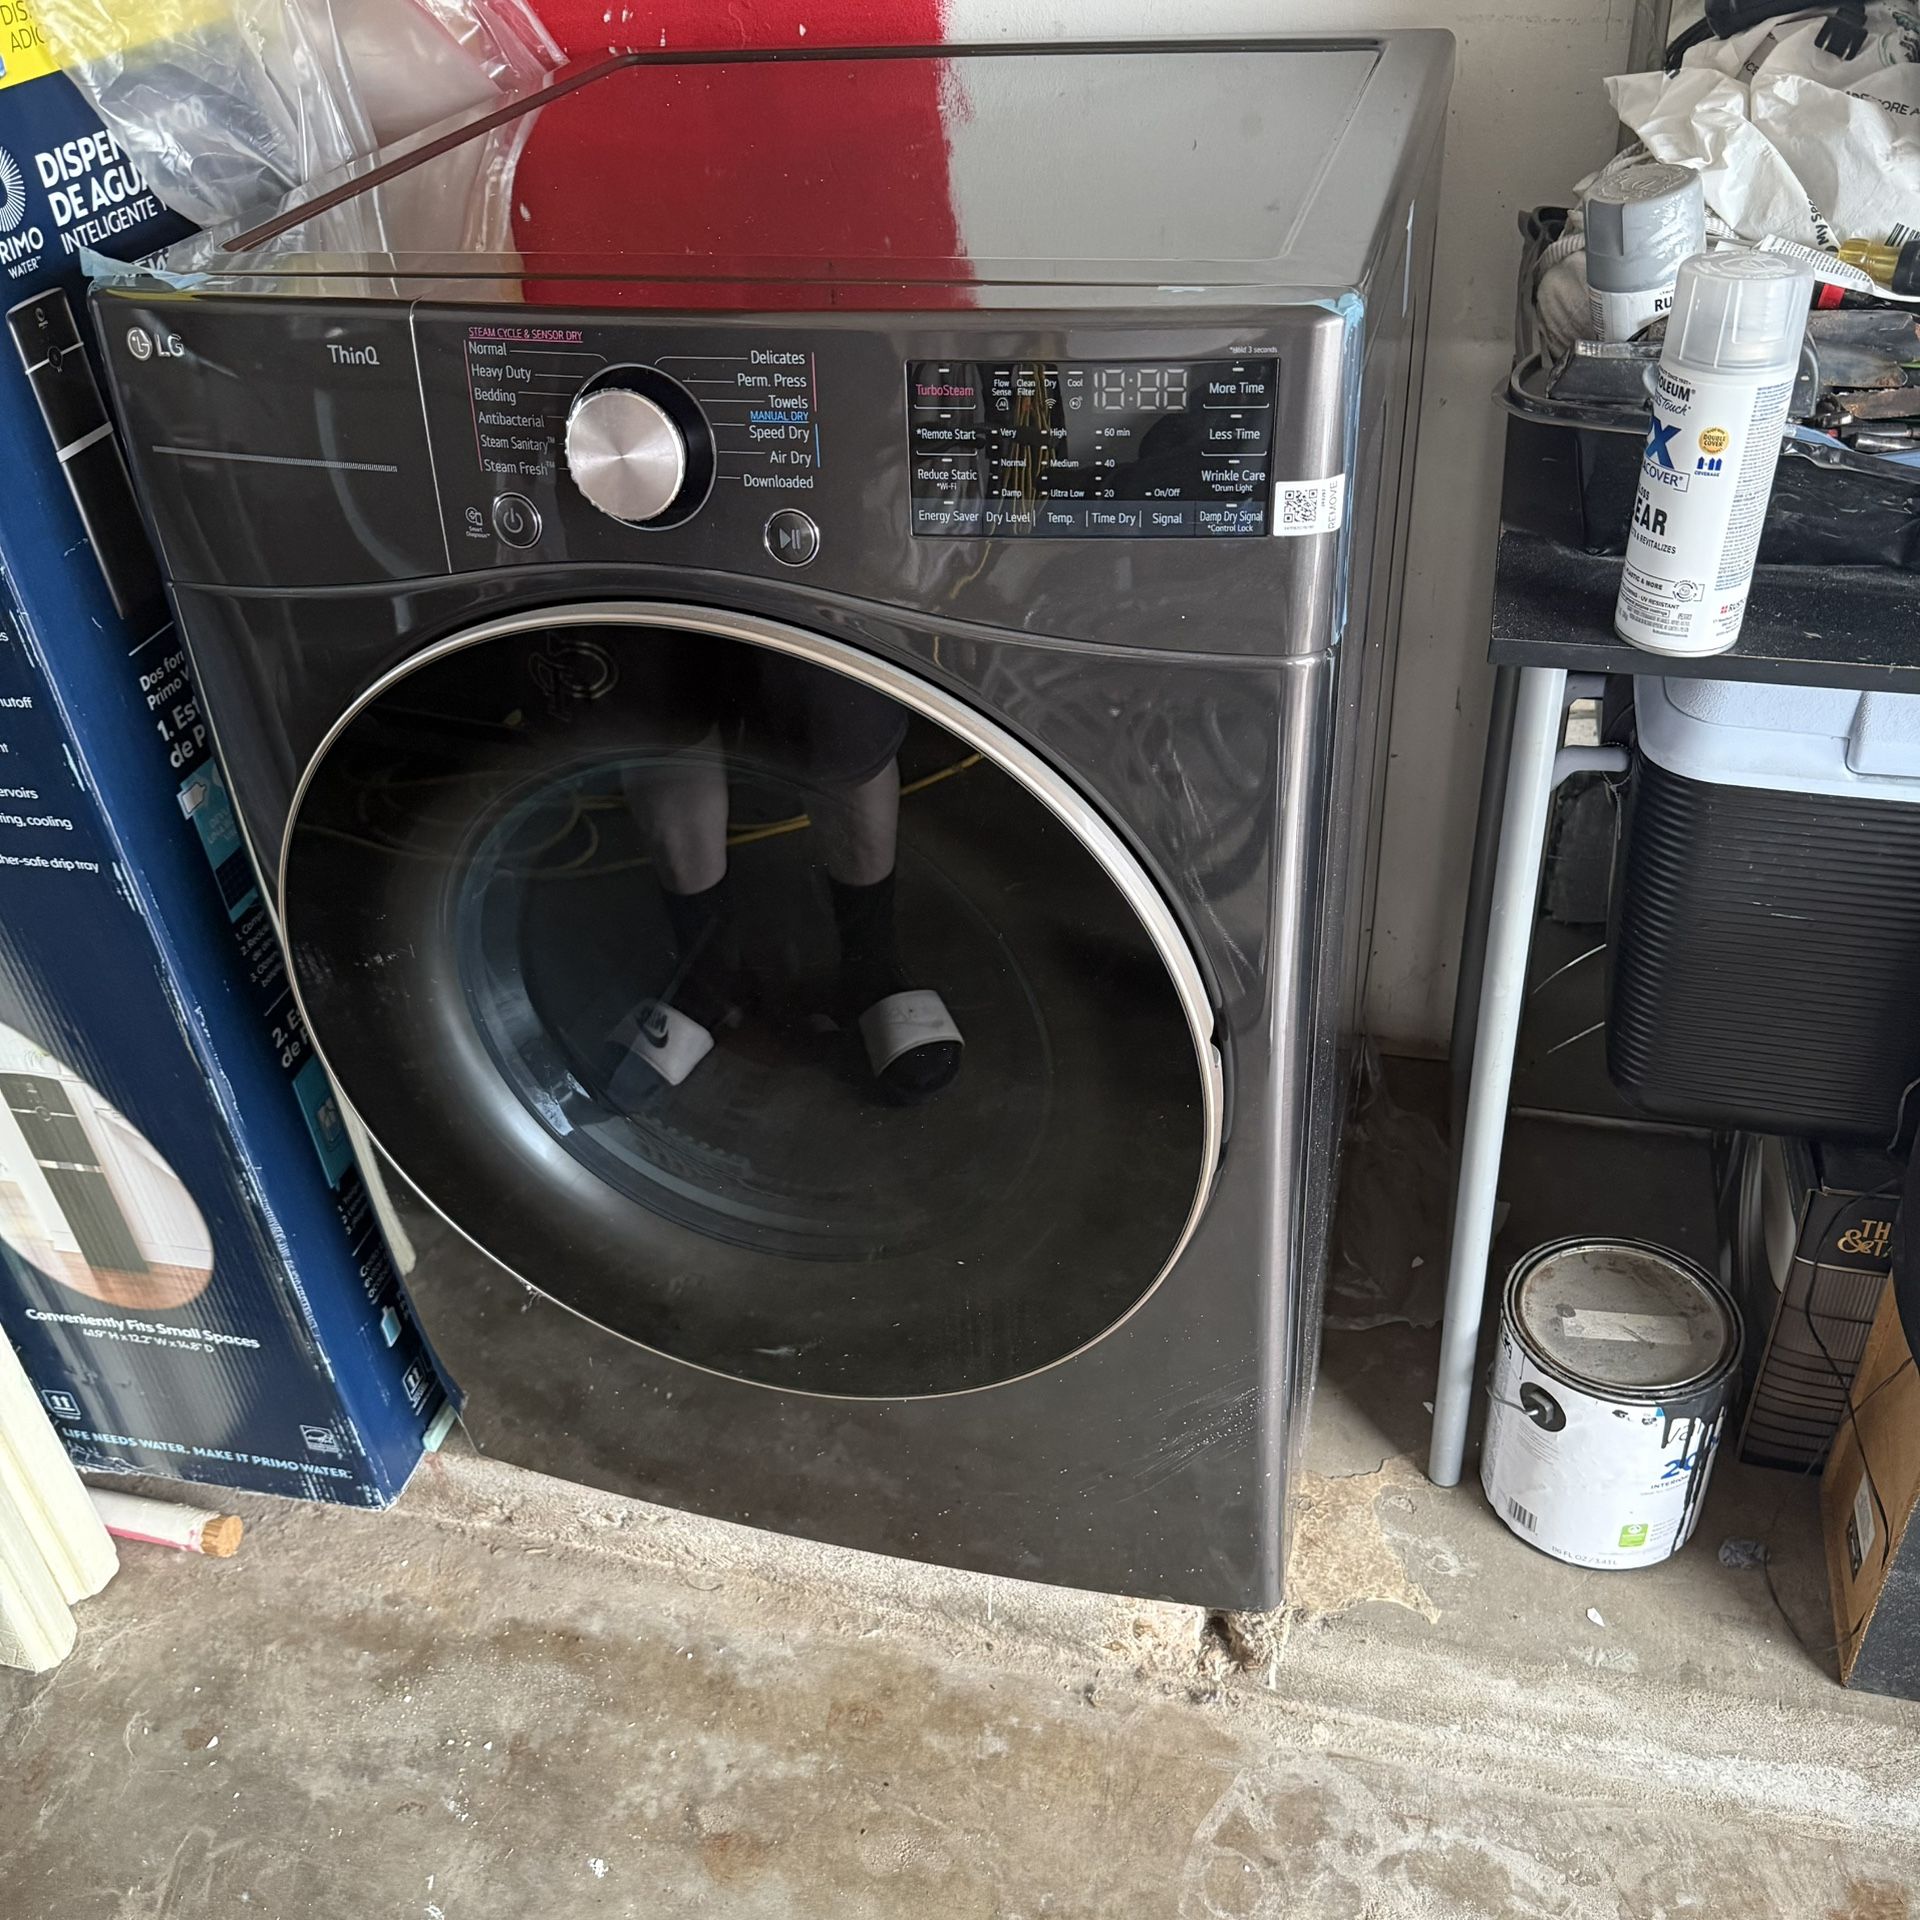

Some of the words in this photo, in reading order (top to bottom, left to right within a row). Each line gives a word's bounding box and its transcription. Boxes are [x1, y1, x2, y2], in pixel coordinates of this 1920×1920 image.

[48, 183, 89, 227] DE
[60, 195, 158, 254] INTELIGENTE
[469, 327, 496, 338] STEAM
[497, 328, 523, 338] CYCLE
[524, 329, 530, 339] &
[531, 330, 564, 340] SENSOR
[566, 331, 582, 341] DRY
[154, 333, 185, 357] LG
[469, 342, 507, 356] Normal
[327, 344, 380, 366] ThinQ
[751, 351, 805, 364] Delicates
[471, 364, 503, 381] Heavy
[506, 365, 531, 382] Duty
[737, 373, 771, 387] Perm.
[774, 374, 807, 388] Press
[993, 379, 1010, 387] Flow
[1017, 379, 1036, 388] Clean
[1044, 379, 1056, 389] Dry
[1067, 379, 1083, 387] Cool
[916, 383, 974, 396] TurboSteam
[992, 388, 1012, 396] Sense
[1017, 388, 1035, 396] Filter
[1209, 383, 1236, 394] More
[1239, 383, 1264, 394] Time
[474, 388, 516, 406] Bedding
[768, 394, 808, 409] Towels
[478, 413, 545, 428] Antibacterial
[750, 411, 788, 421] MANUAL
[790, 412, 809, 421] DRY
[749, 425, 785, 441] Speed
[789, 426, 810, 443] Dry
[955, 429, 976, 440] Start
[1000, 428, 1016, 439] Very
[1050, 429, 1067, 438] High
[1104, 429, 1115, 437] 60
[1117, 429, 1130, 437] min
[1209, 429, 1232, 440] Less
[1235, 429, 1260, 440] Time
[480, 435, 509, 449] Steam
[484, 459, 516, 473] Steam
[770, 451, 786, 464] Air
[790, 452, 812, 468] Dry
[1001, 459, 1026, 467] Normal
[1050, 459, 1079, 467] Medium
[743, 474, 813, 489] Downloaded
[918, 469, 949, 480] Reduce
[951, 470, 977, 481] Static
[1201, 470, 1240, 481] Wrinkle
[1242, 471, 1266, 481] Care
[1002, 489, 1022, 498] Damp
[1050, 489, 1068, 497] Ultra
[1070, 489, 1084, 497] Low
[1154, 488, 1180, 498] On/Off
[1234, 484, 1253, 493] Light
[919, 511, 950, 523] Energy
[953, 512, 979, 521] Saver
[986, 512, 1001, 525] Dry
[1005, 512, 1030, 523] Level
[1047, 513, 1075, 524] Temp.
[1092, 513, 1116, 524] Time
[1118, 513, 1136, 526] Dry
[1152, 513, 1182, 525] Signal
[1200, 511, 1219, 524] Damp
[1220, 511, 1237, 524] Dry
[1239, 511, 1263, 524] Signal
[1238, 524, 1253, 532] Lock
[1639, 534, 1677, 555] REVITALIZES
[139, 667, 164, 691] Dos
[146, 678, 182, 711] Primo
[157, 720, 174, 741] 1.
[170, 739, 194, 768] de
[26, 816, 73, 831] cooling
[50, 858, 75, 871] drip
[75, 860, 99, 873] tray
[272, 1026, 288, 1048] 2.
[281, 1040, 301, 1068] de
[26, 1308, 124, 1331] Conveniently
[125, 1318, 155, 1334] Fits
[155, 1323, 201, 1339] Small
[202, 1330, 261, 1348] Spaces
[108, 1331, 119, 1340] H
[153, 1337, 167, 1346] W
[204, 1344, 214, 1352] D
[62, 1427, 91, 1440] LIFE
[92, 1432, 138, 1447] NEEDS
[138, 1439, 190, 1454] WATER.
[192, 1447, 234, 1461] MAKE
[235, 1452, 248, 1463] IT
[251, 1455, 300, 1471] PRIMO
